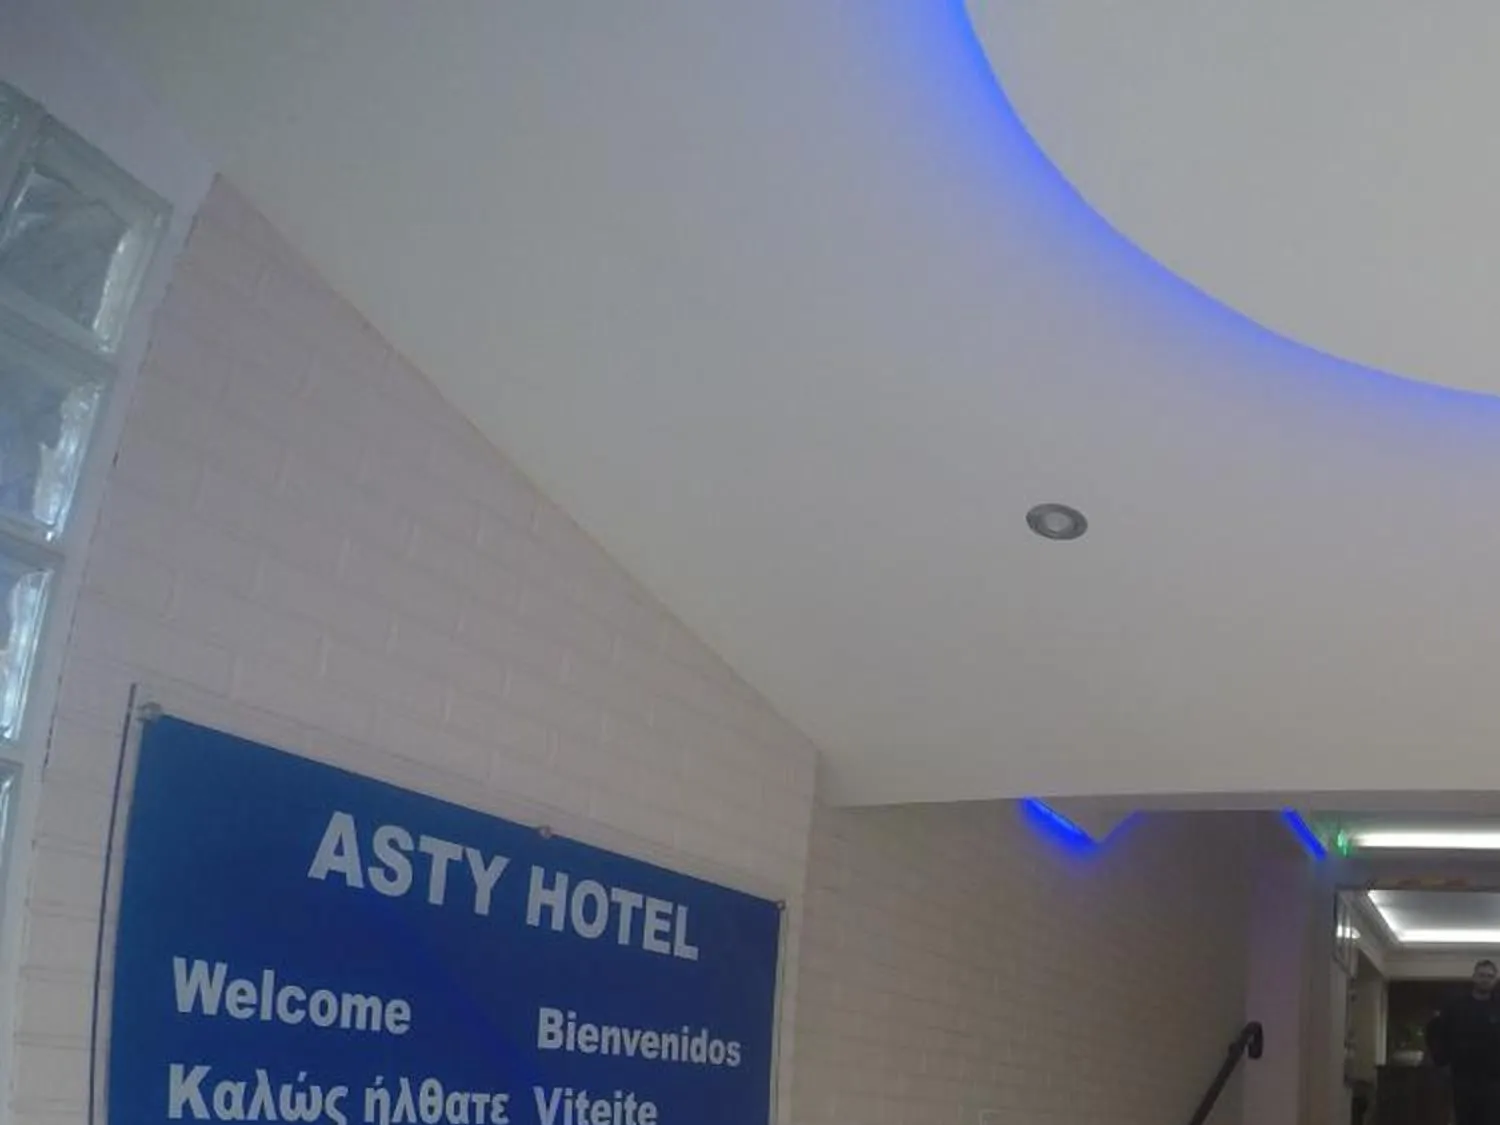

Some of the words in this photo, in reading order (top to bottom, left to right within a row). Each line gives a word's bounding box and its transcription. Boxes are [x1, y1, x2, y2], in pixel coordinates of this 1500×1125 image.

[308, 811, 508, 915] ASTY
[526, 866, 699, 960] HOTEL
[172, 957, 411, 1034] Welcome
[538, 1007, 741, 1066] Bienvenidos
